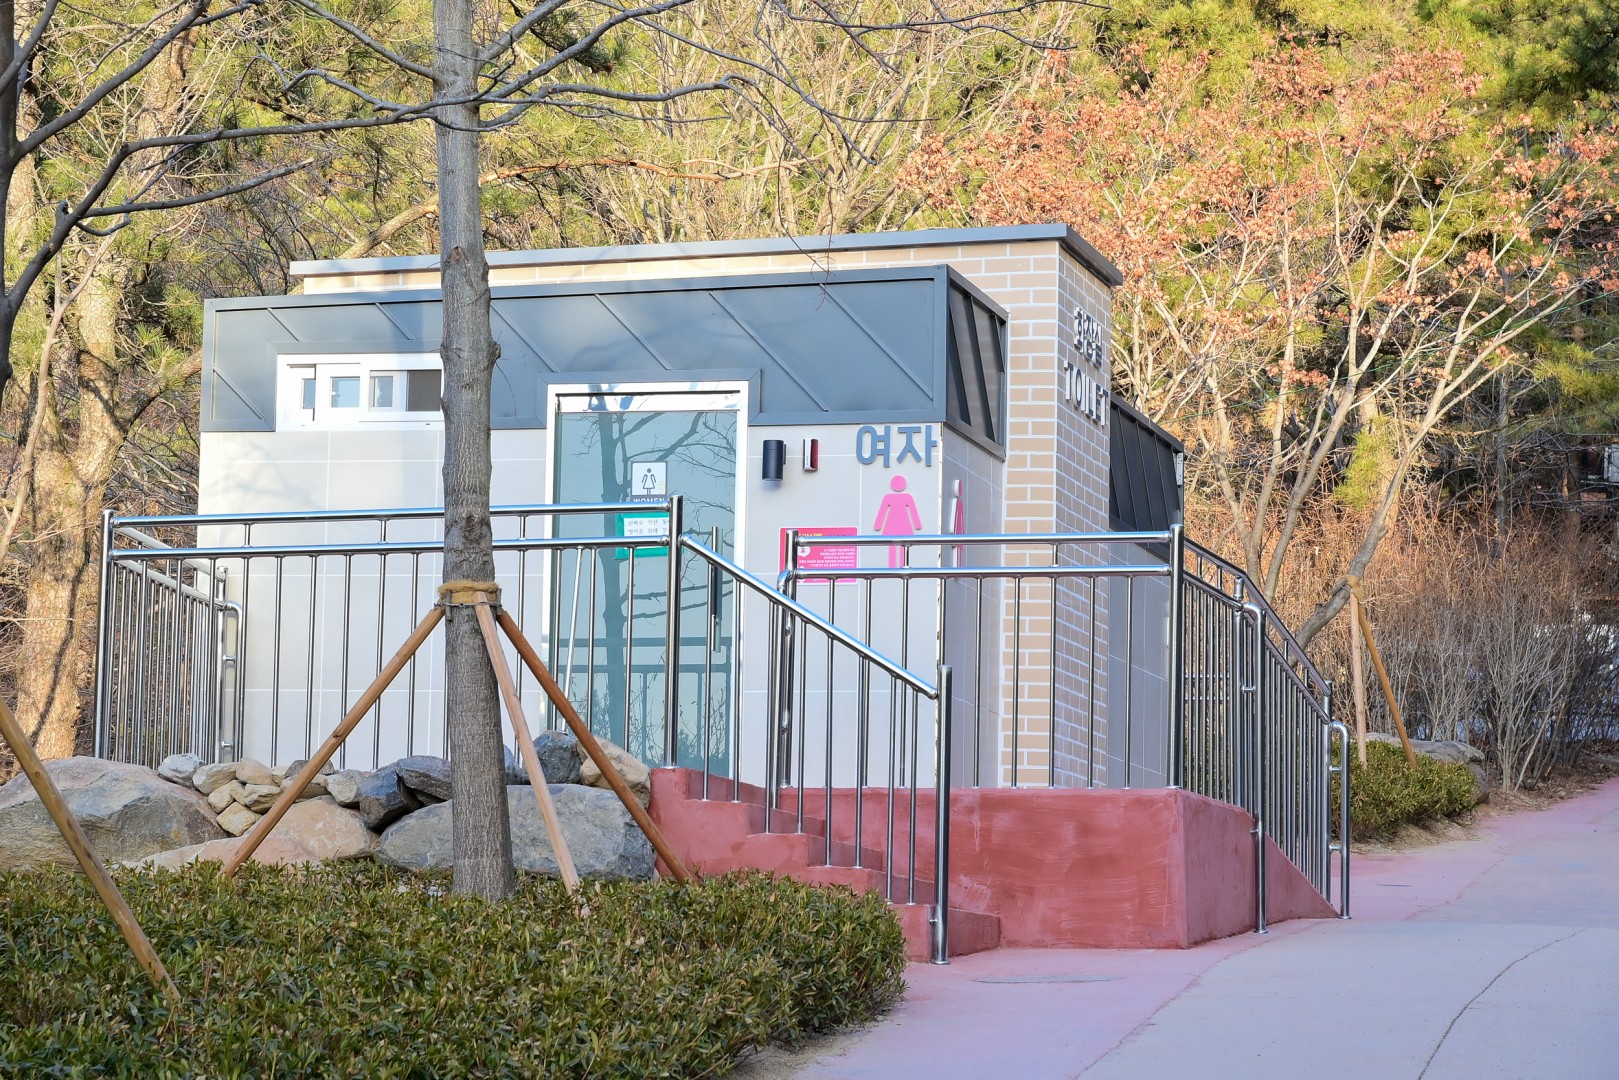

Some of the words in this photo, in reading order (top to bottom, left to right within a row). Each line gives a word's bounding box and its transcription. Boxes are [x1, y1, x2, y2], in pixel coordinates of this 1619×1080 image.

[1073, 306, 1102, 367] 화장실
[1063, 360, 1109, 426] TOILET
[856, 425, 937, 468] 여자
